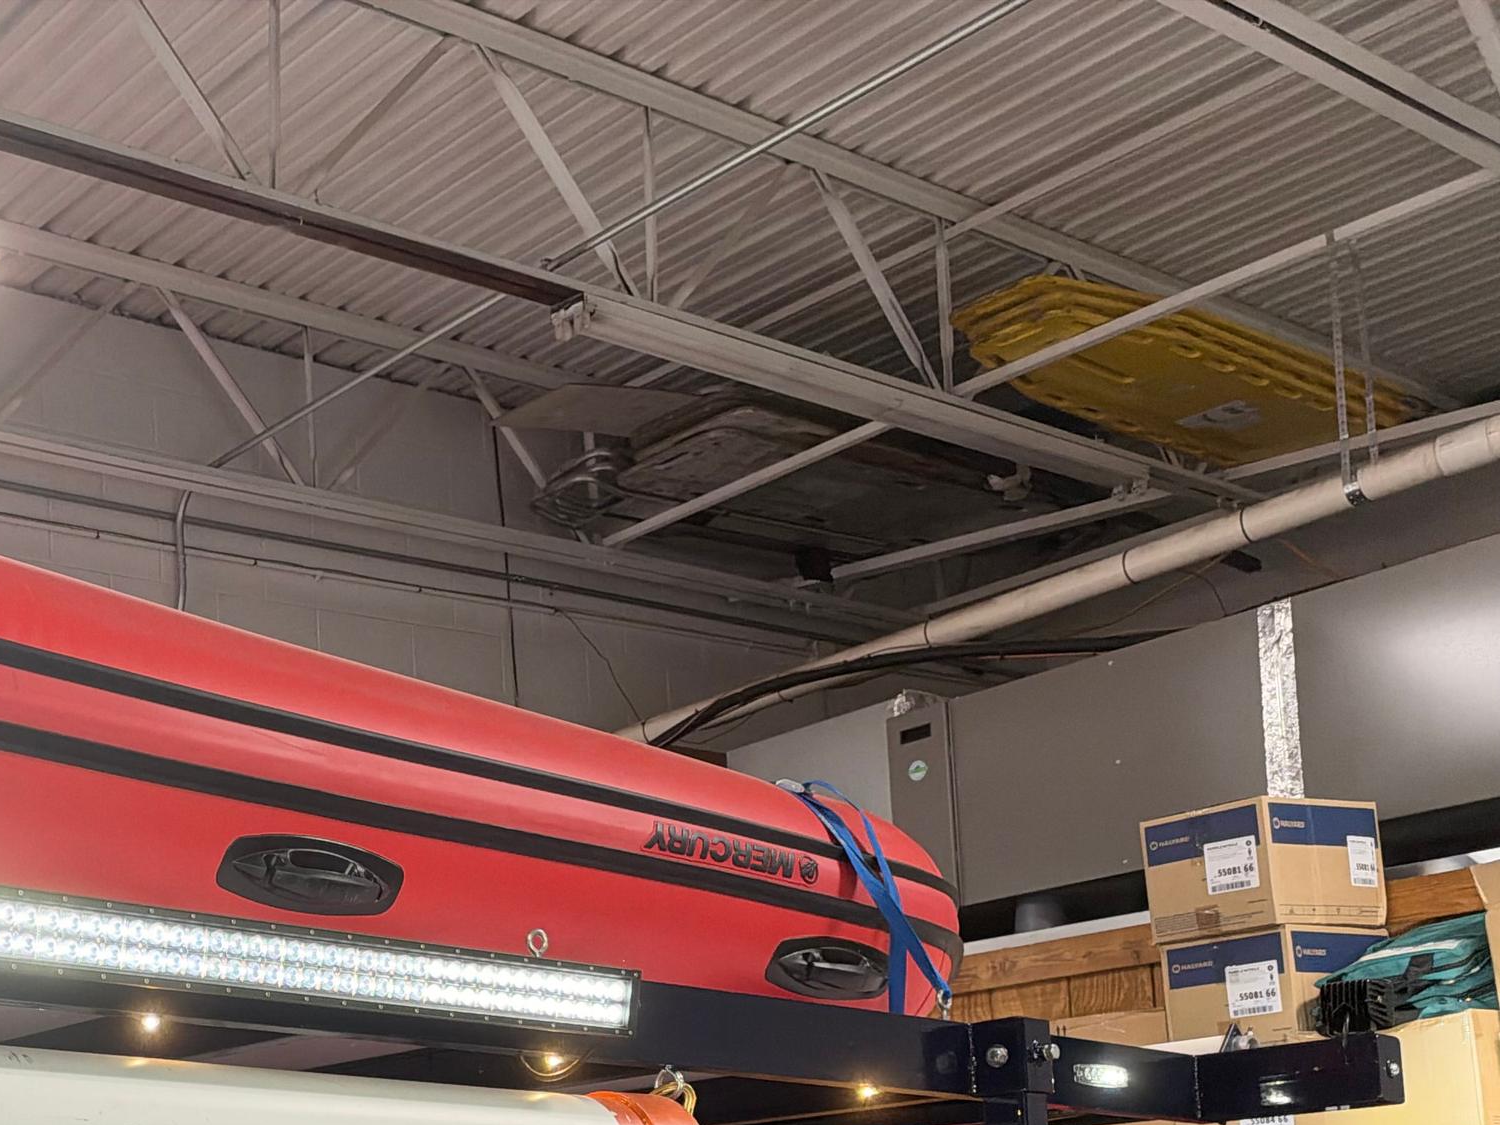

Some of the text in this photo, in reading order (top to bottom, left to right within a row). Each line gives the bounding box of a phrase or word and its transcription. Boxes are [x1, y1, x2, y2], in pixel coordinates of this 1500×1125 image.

[644, 821, 794, 879] MERCURY
[1239, 988, 1276, 1001] 55081 66
